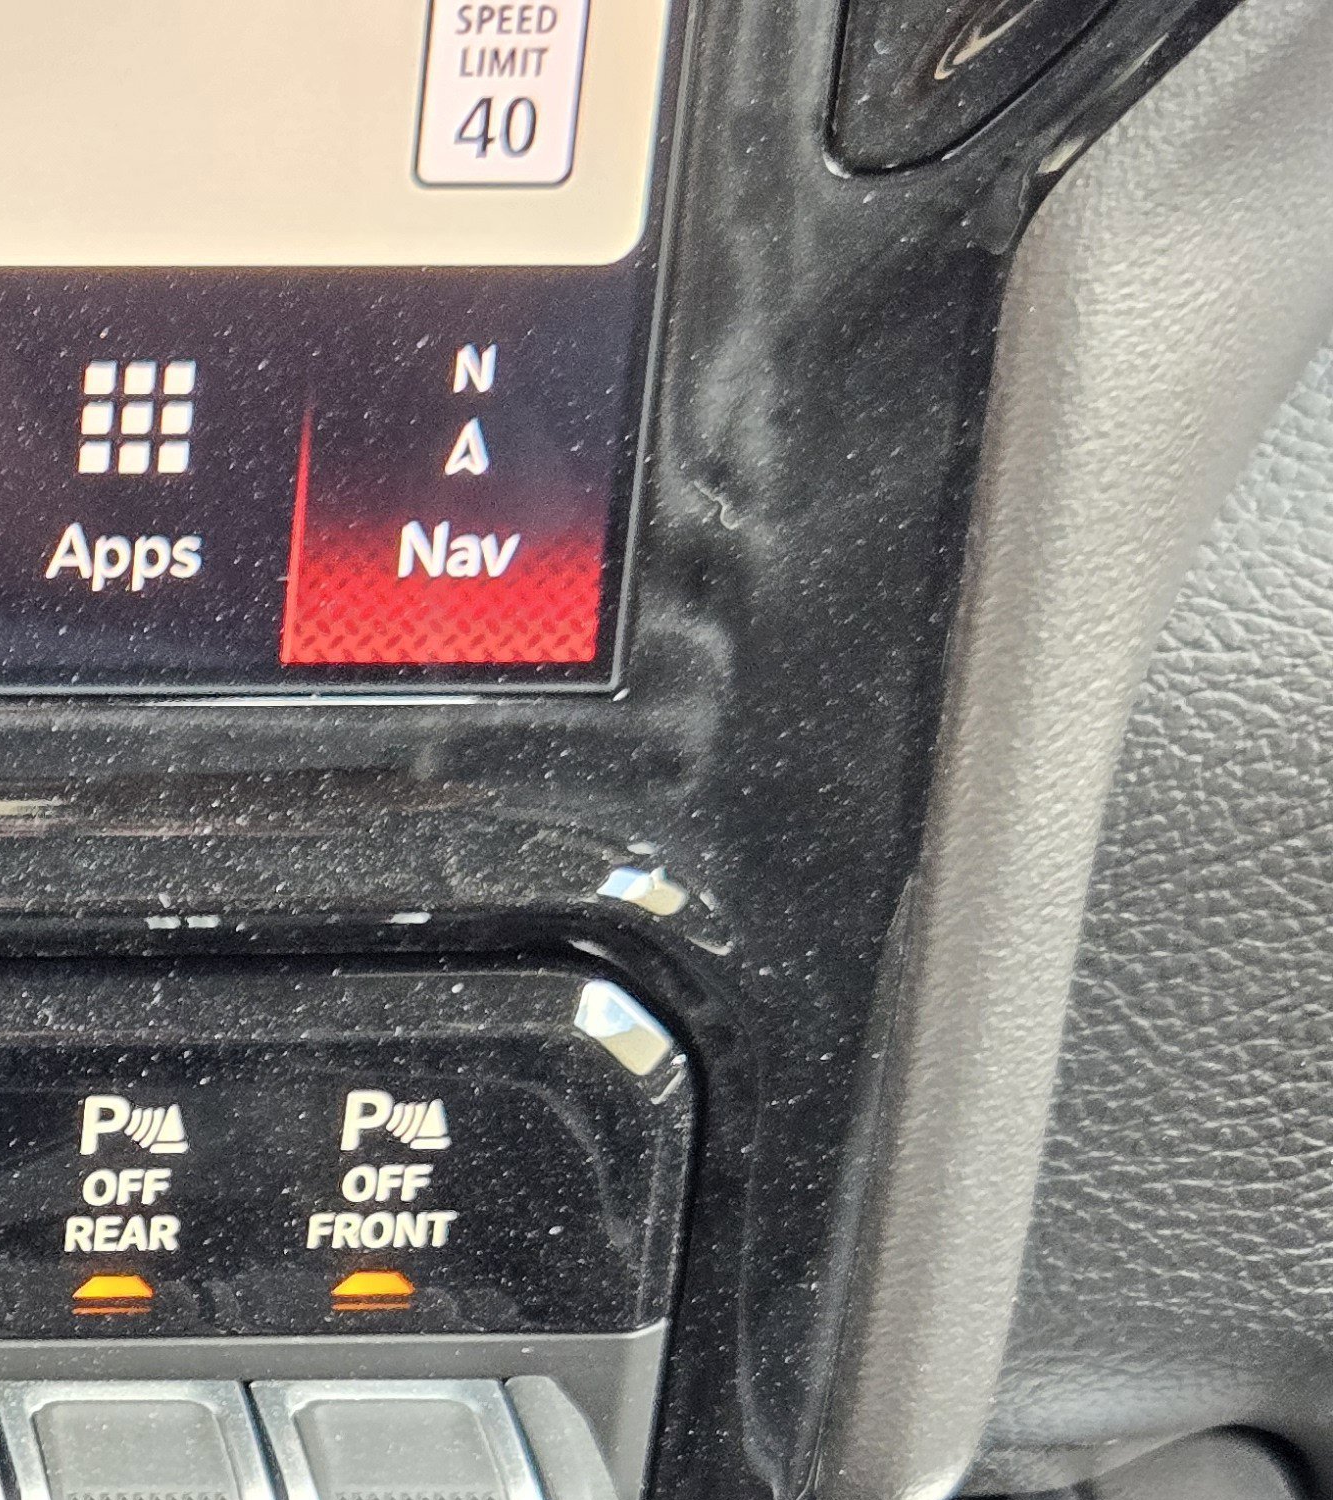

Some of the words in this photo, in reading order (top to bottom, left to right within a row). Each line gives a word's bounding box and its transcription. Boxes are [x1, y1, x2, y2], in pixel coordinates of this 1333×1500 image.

[456, 4, 558, 35] SPEED
[459, 46, 549, 77] LIMIT
[453, 95, 538, 158] 40
[453, 344, 496, 393] N
[45, 522, 202, 592] Apps
[397, 521, 520, 578] Nav
[82, 1168, 172, 1207] OFF
[341, 1163, 434, 1203] OFF
[64, 1214, 181, 1253] REAR
[306, 1210, 458, 1250] FRONT
